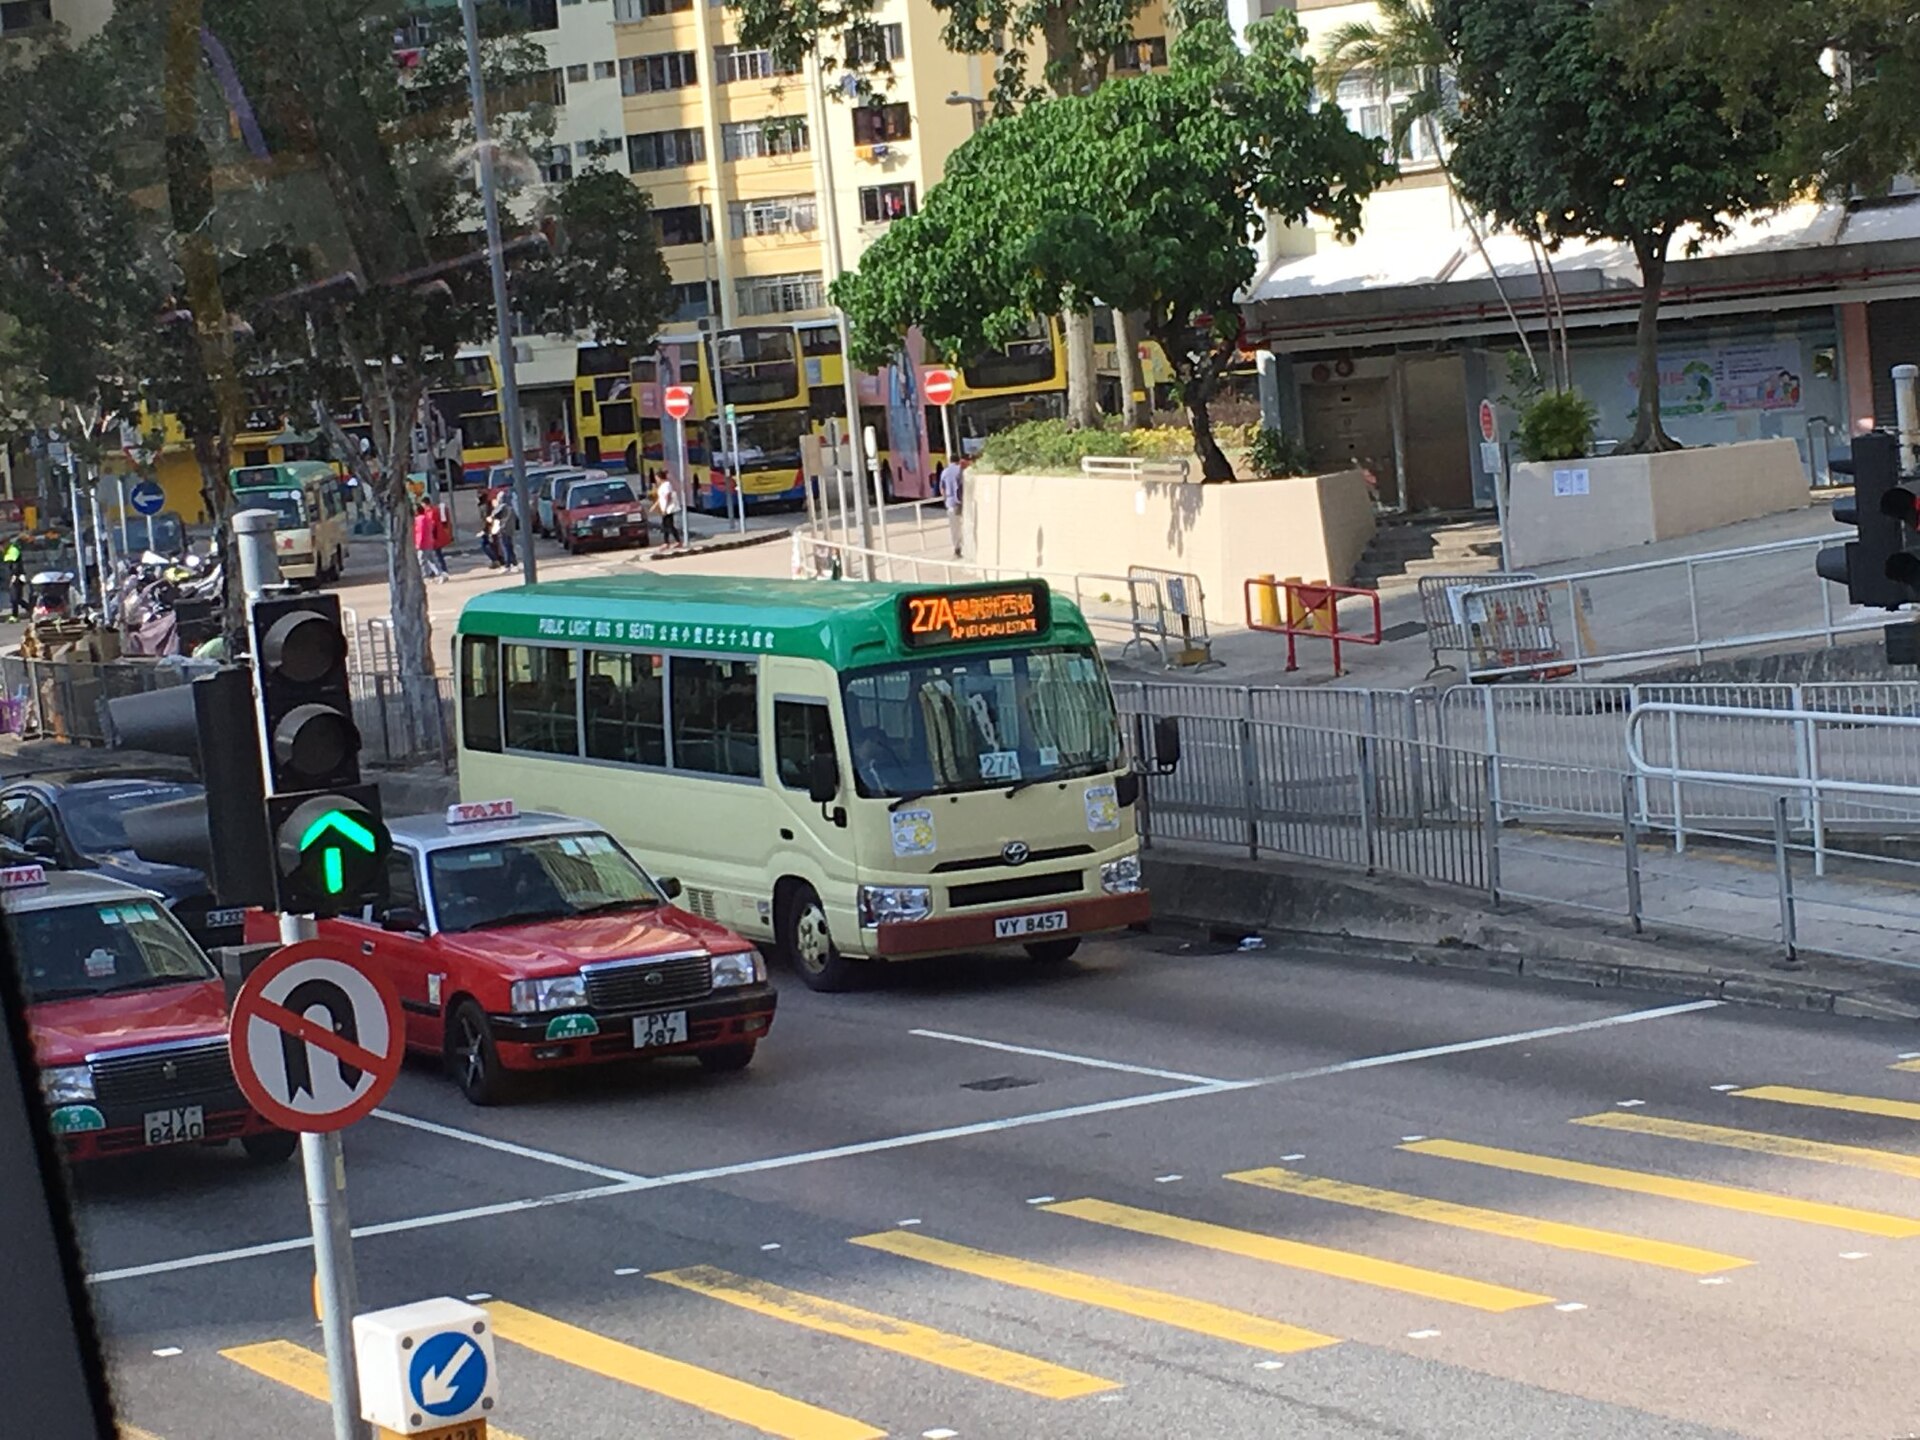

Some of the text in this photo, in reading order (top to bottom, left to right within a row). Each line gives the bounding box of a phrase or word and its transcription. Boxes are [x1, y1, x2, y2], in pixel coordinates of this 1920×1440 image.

[909, 597, 957, 632] 27A
[539, 618, 566, 635] PUBLIC
[568, 619, 592, 636] LIGHT
[595, 621, 611, 637] BUS
[628, 622, 655, 640] SEATS
[951, 626, 964, 639] AP
[980, 622, 1005, 637] CHAU
[1006, 618, 1038, 634] ESTATE
[982, 754, 1018, 779] 27A
[458, 801, 513, 819] TAXI
[2, 868, 42, 883] TAXI
[999, 913, 1065, 935] VY 8457
[648, 1013, 670, 1030] PY
[644, 1028, 677, 1045] 287
[161, 1107, 188, 1127] JY
[149, 1122, 202, 1144] 8440
